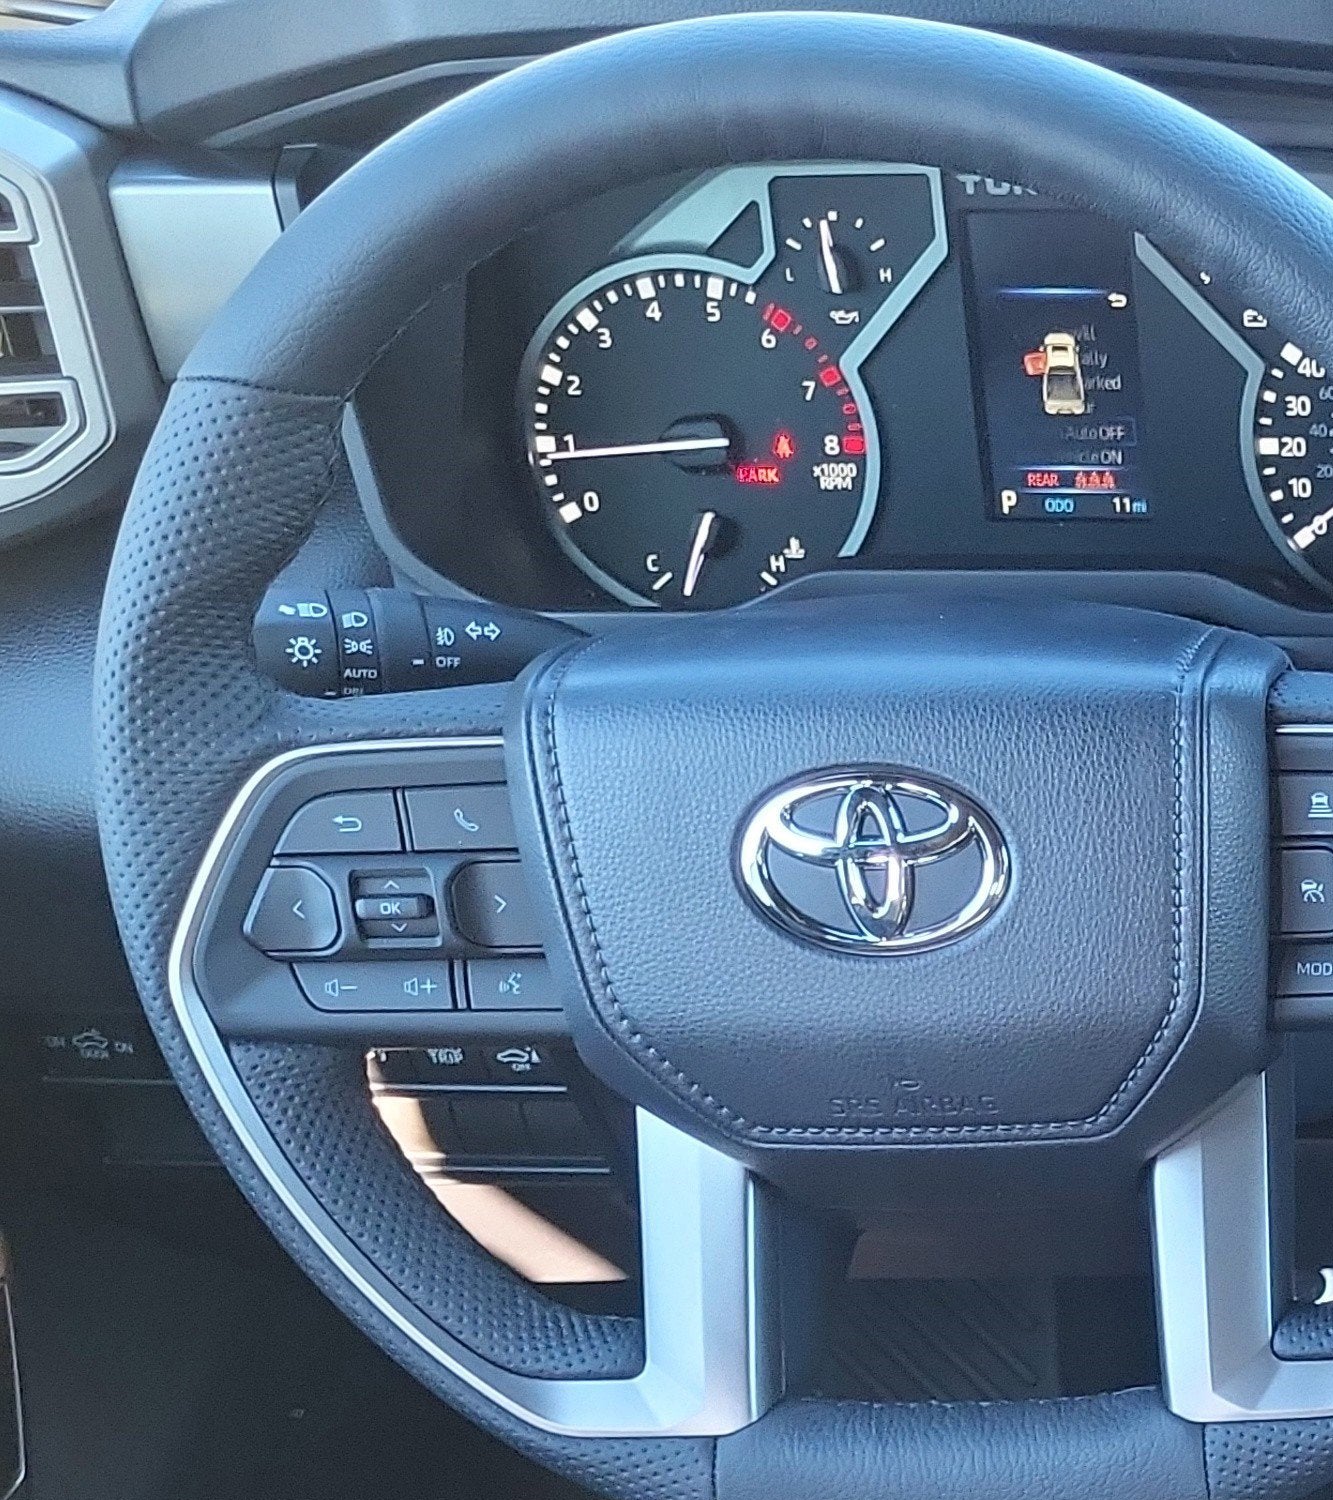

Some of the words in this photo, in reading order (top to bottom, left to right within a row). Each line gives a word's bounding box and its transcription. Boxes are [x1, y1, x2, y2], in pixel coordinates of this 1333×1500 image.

[786, 268, 794, 281] L
[880, 268, 892, 282] H
[646, 303, 661, 321] 4
[706, 303, 720, 322] 5
[599, 329, 612, 348] 3
[761, 330, 776, 348] 6
[567, 377, 582, 396] 2
[802, 382, 816, 400] 7
[1285, 396, 1311, 416] 30
[1309, 424, 1327, 438] 40
[563, 435, 575, 453] 1
[824, 436, 839, 455] 8
[1281, 437, 1306, 457] 20
[736, 467, 781, 483] PARK
[1028, 473, 1059, 487] REAR
[1316, 464, 1333, 479] 20
[819, 476, 852, 491] RPM
[1288, 478, 1311, 498] 10
[583, 492, 599, 511] 0
[1001, 490, 1017, 514] P
[1112, 497, 1131, 513] 11
[646, 555, 658, 571] C
[769, 556, 784, 572] H
[435, 656, 461, 668] OFF
[343, 668, 378, 679] AUTO
[380, 902, 401, 915] OK
